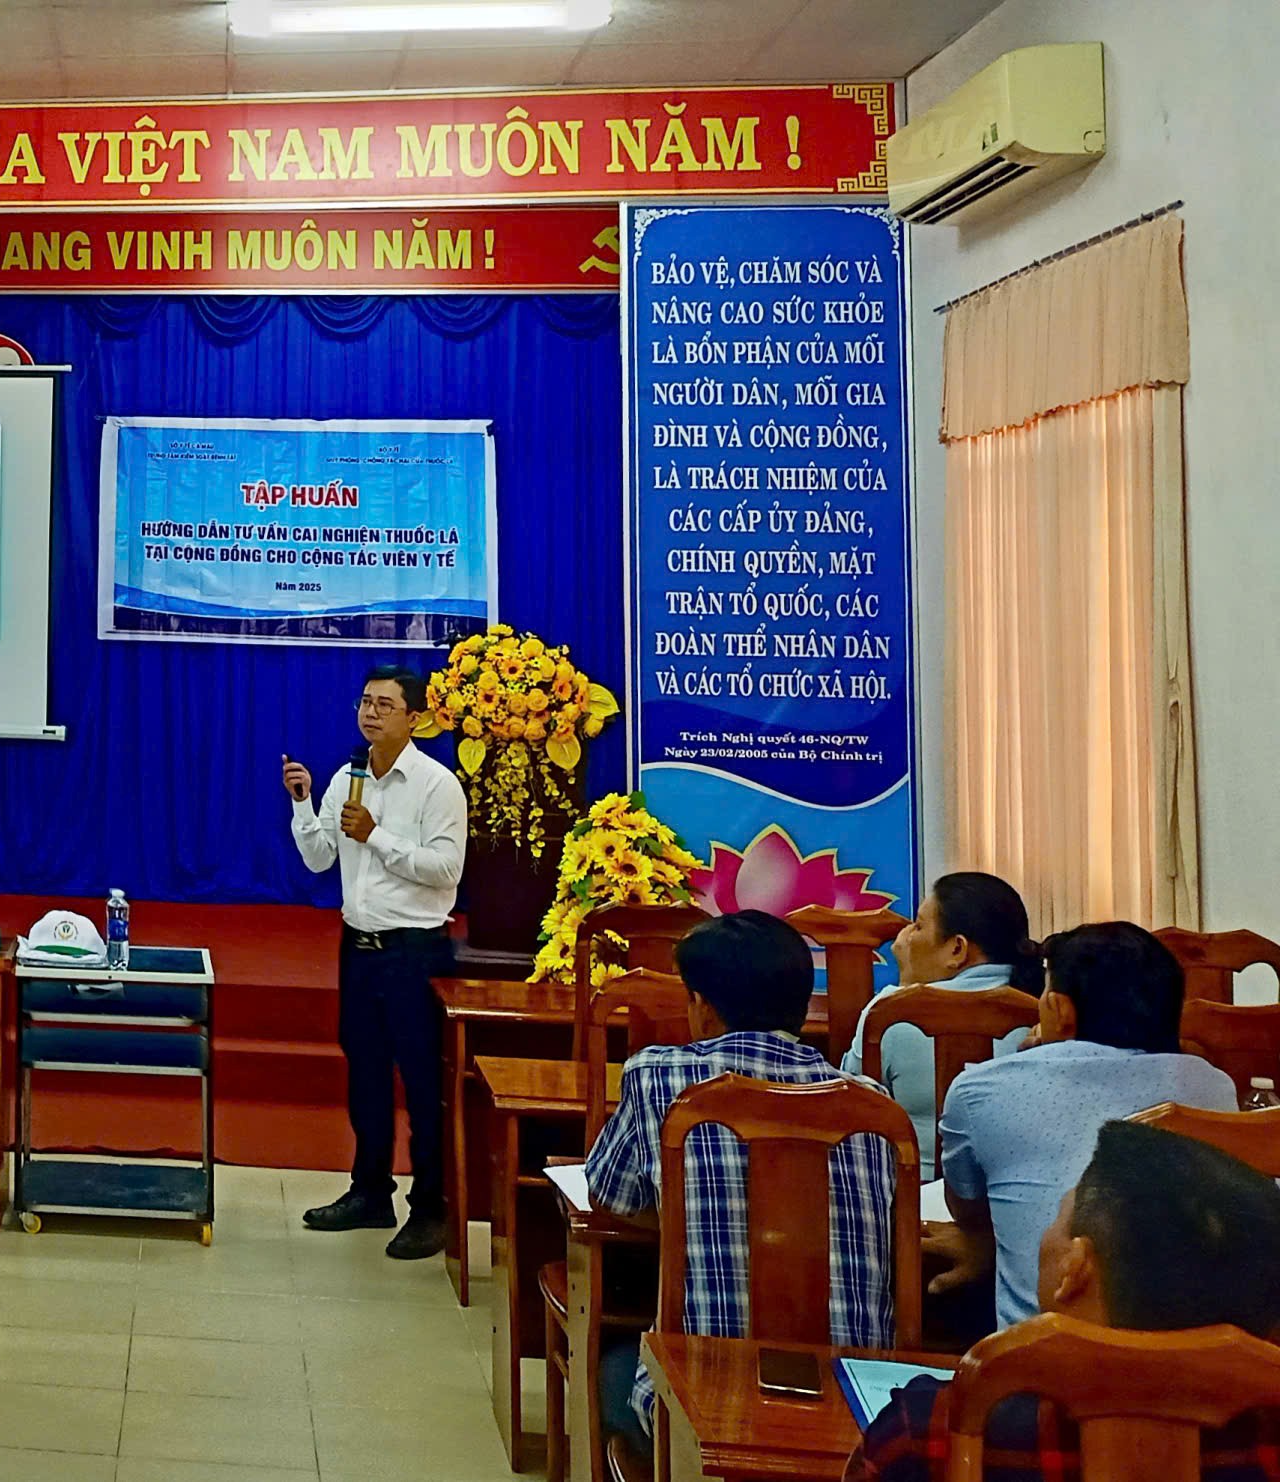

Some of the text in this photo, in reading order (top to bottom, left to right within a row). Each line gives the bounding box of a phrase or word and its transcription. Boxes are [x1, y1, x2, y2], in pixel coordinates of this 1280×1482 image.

[58, 116, 210, 196] VIỆT
[228, 127, 376, 182] NAM
[395, 106, 583, 178] MUÔN
[605, 103, 761, 172] NĂM
[107, 231, 211, 270] VINH
[226, 219, 359, 272] MUÔN
[652, 254, 882, 289] BẢO VỆ, CHĂM SÓC VÀ
[652, 292, 883, 323] NÂNG CAO SỨC KHỎE
[652, 331, 884, 369] LÀ BỔN PHẬN CỦA MỖI
[653, 376, 885, 409] NGƯỜI DÂN, MỖI GIA
[242, 480, 359, 510] TẬP HUẤN
[141, 522, 458, 545] HƯỚNG DẪN TƯ VẤN CAI NGHIỆN THUỐC LÁ
[145, 545, 169, 565] TẠI
[173, 545, 215, 564] CỘNG
[267, 549, 296, 564] CHO
[302, 548, 344, 569] CỘNG
[349, 549, 377, 566] TÁC
[382, 548, 417, 566] VIÊN
[423, 552, 432, 566] Y
[436, 548, 455, 567] TẾ
[275, 580, 322, 592] Năm 2025
[680, 732, 868, 745] Trích Nghị quyết 46-NQ/TW
[665, 747, 698, 758] Ngày
[771, 750, 796, 759] của
[799, 751, 816, 762] Bộ
[821, 750, 863, 760] Chính
[866, 752, 882, 763] trị
